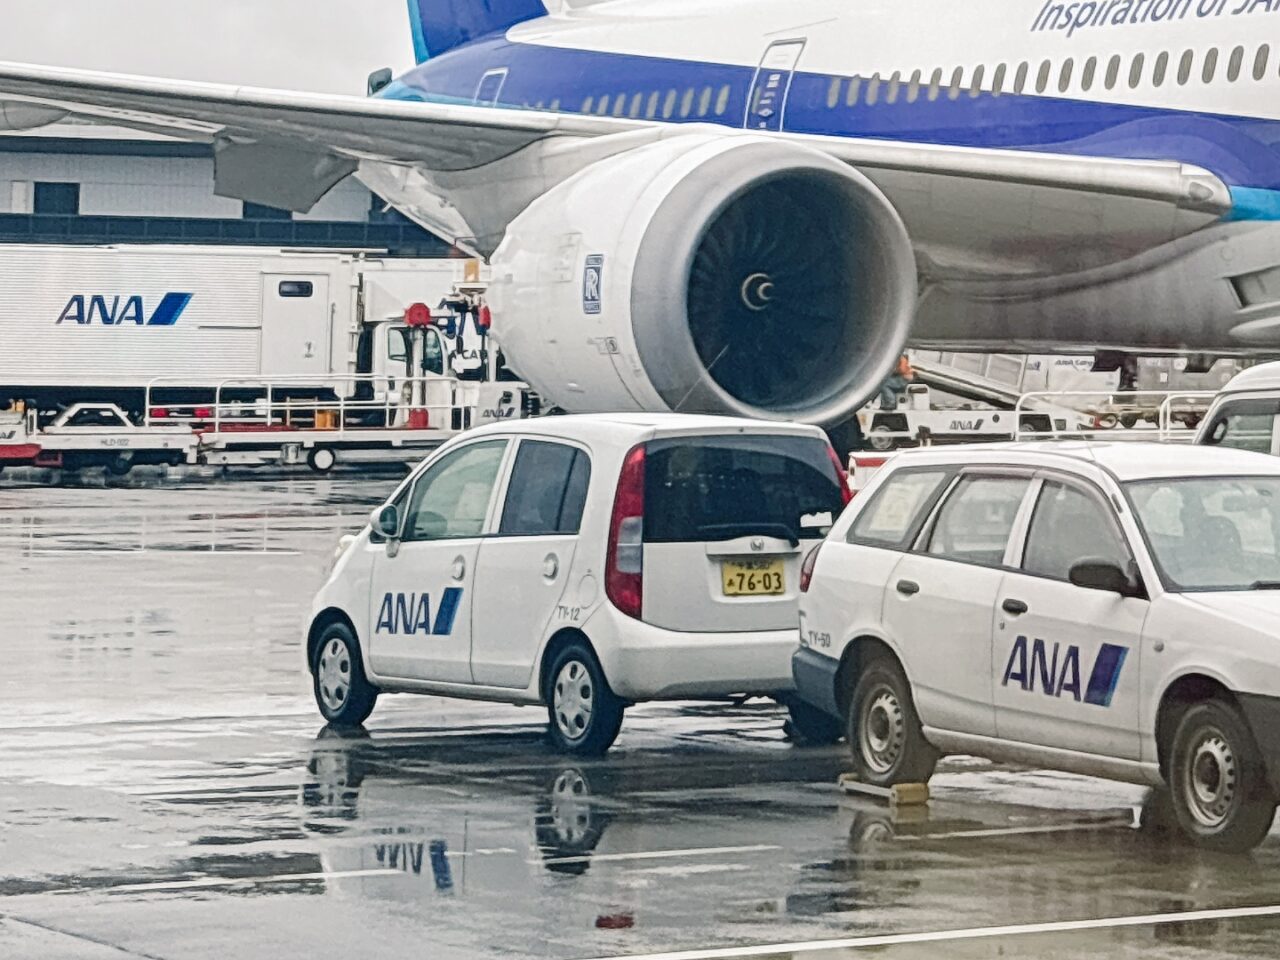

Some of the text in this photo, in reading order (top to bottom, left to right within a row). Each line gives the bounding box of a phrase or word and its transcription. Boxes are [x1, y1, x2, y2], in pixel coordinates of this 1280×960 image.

[55, 294, 144, 324] ANA
[482, 409, 504, 418] ANA
[950, 420, 974, 431] ANA
[736, 572, 782, 591] 76-03
[375, 593, 430, 635] ANA
[1002, 635, 1082, 702] ANA
